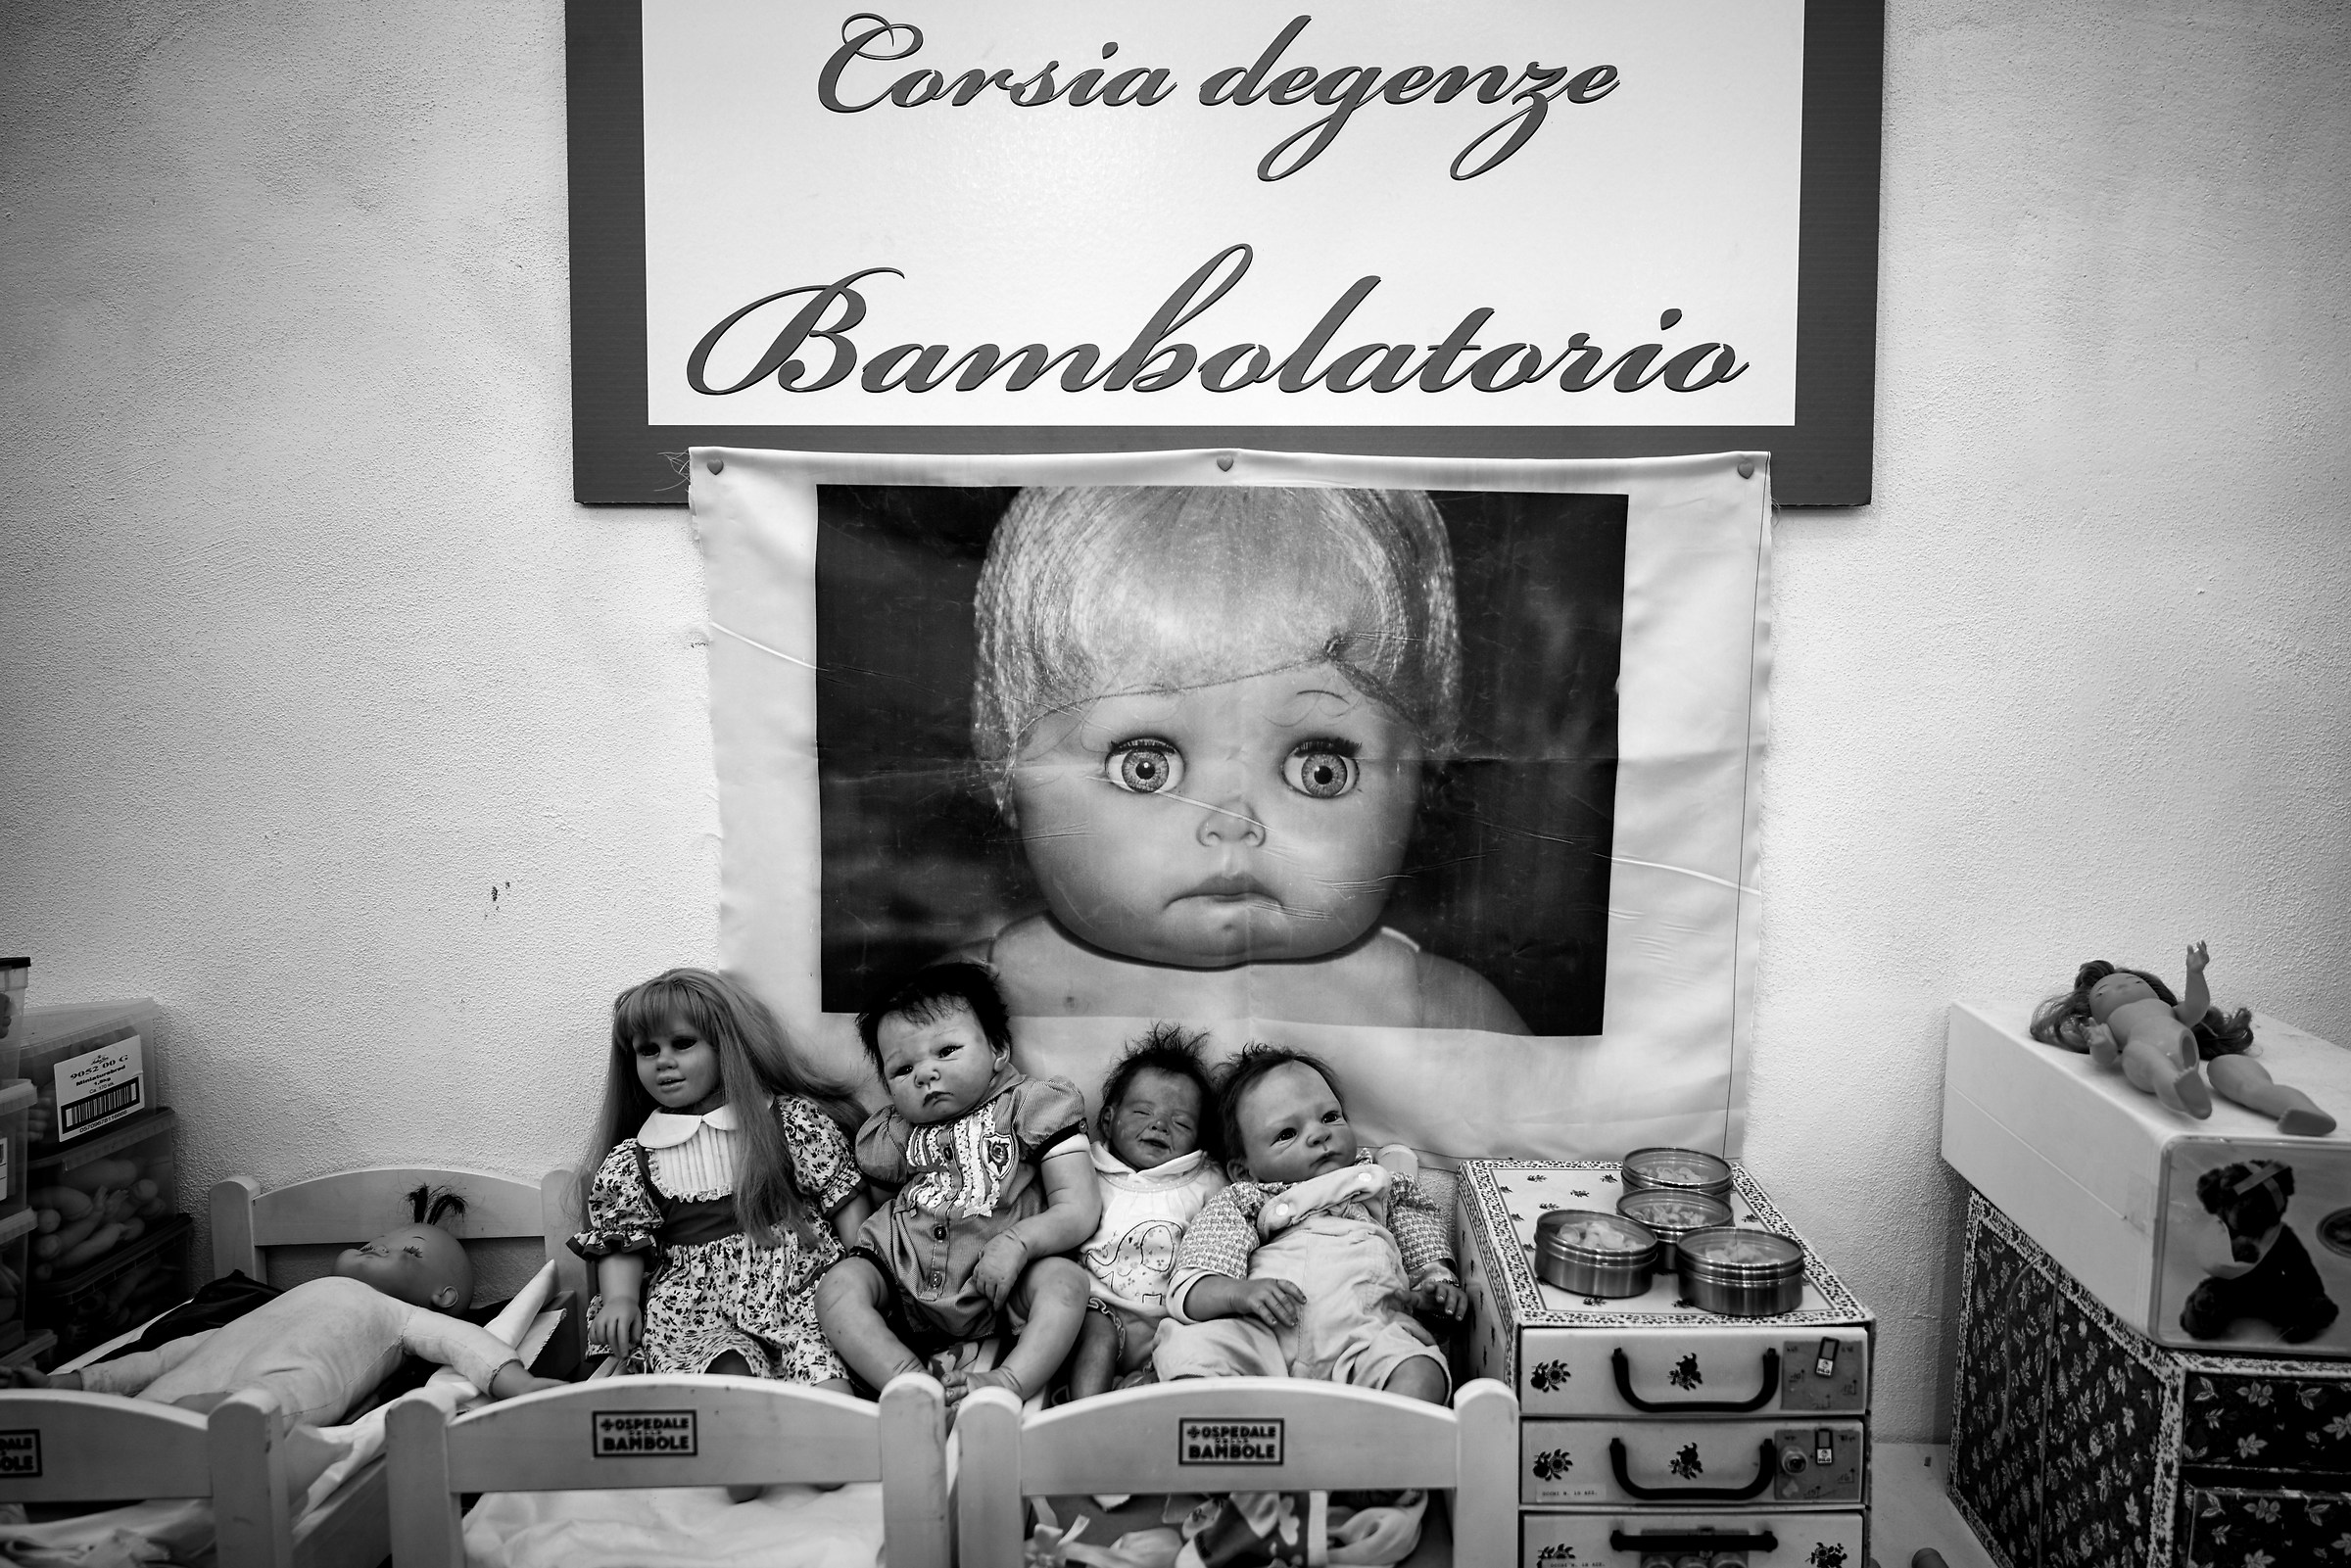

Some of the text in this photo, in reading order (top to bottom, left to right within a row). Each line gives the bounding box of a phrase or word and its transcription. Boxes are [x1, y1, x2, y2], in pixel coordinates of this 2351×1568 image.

[818, 13, 1621, 182] Corsia degenze
[686, 243, 1751, 397] Bambolatorio
[70, 1066, 100, 1080] 9052
[102, 1060, 117, 1069] 00
[614, 1417, 690, 1430] OSPEDALE
[1201, 1425, 1276, 1438] OSPEDALE
[602, 1435, 690, 1451] BAMBOLE
[1188, 1444, 1275, 1458] BAMBOLE
[0, 1455, 34, 1471] OLE
